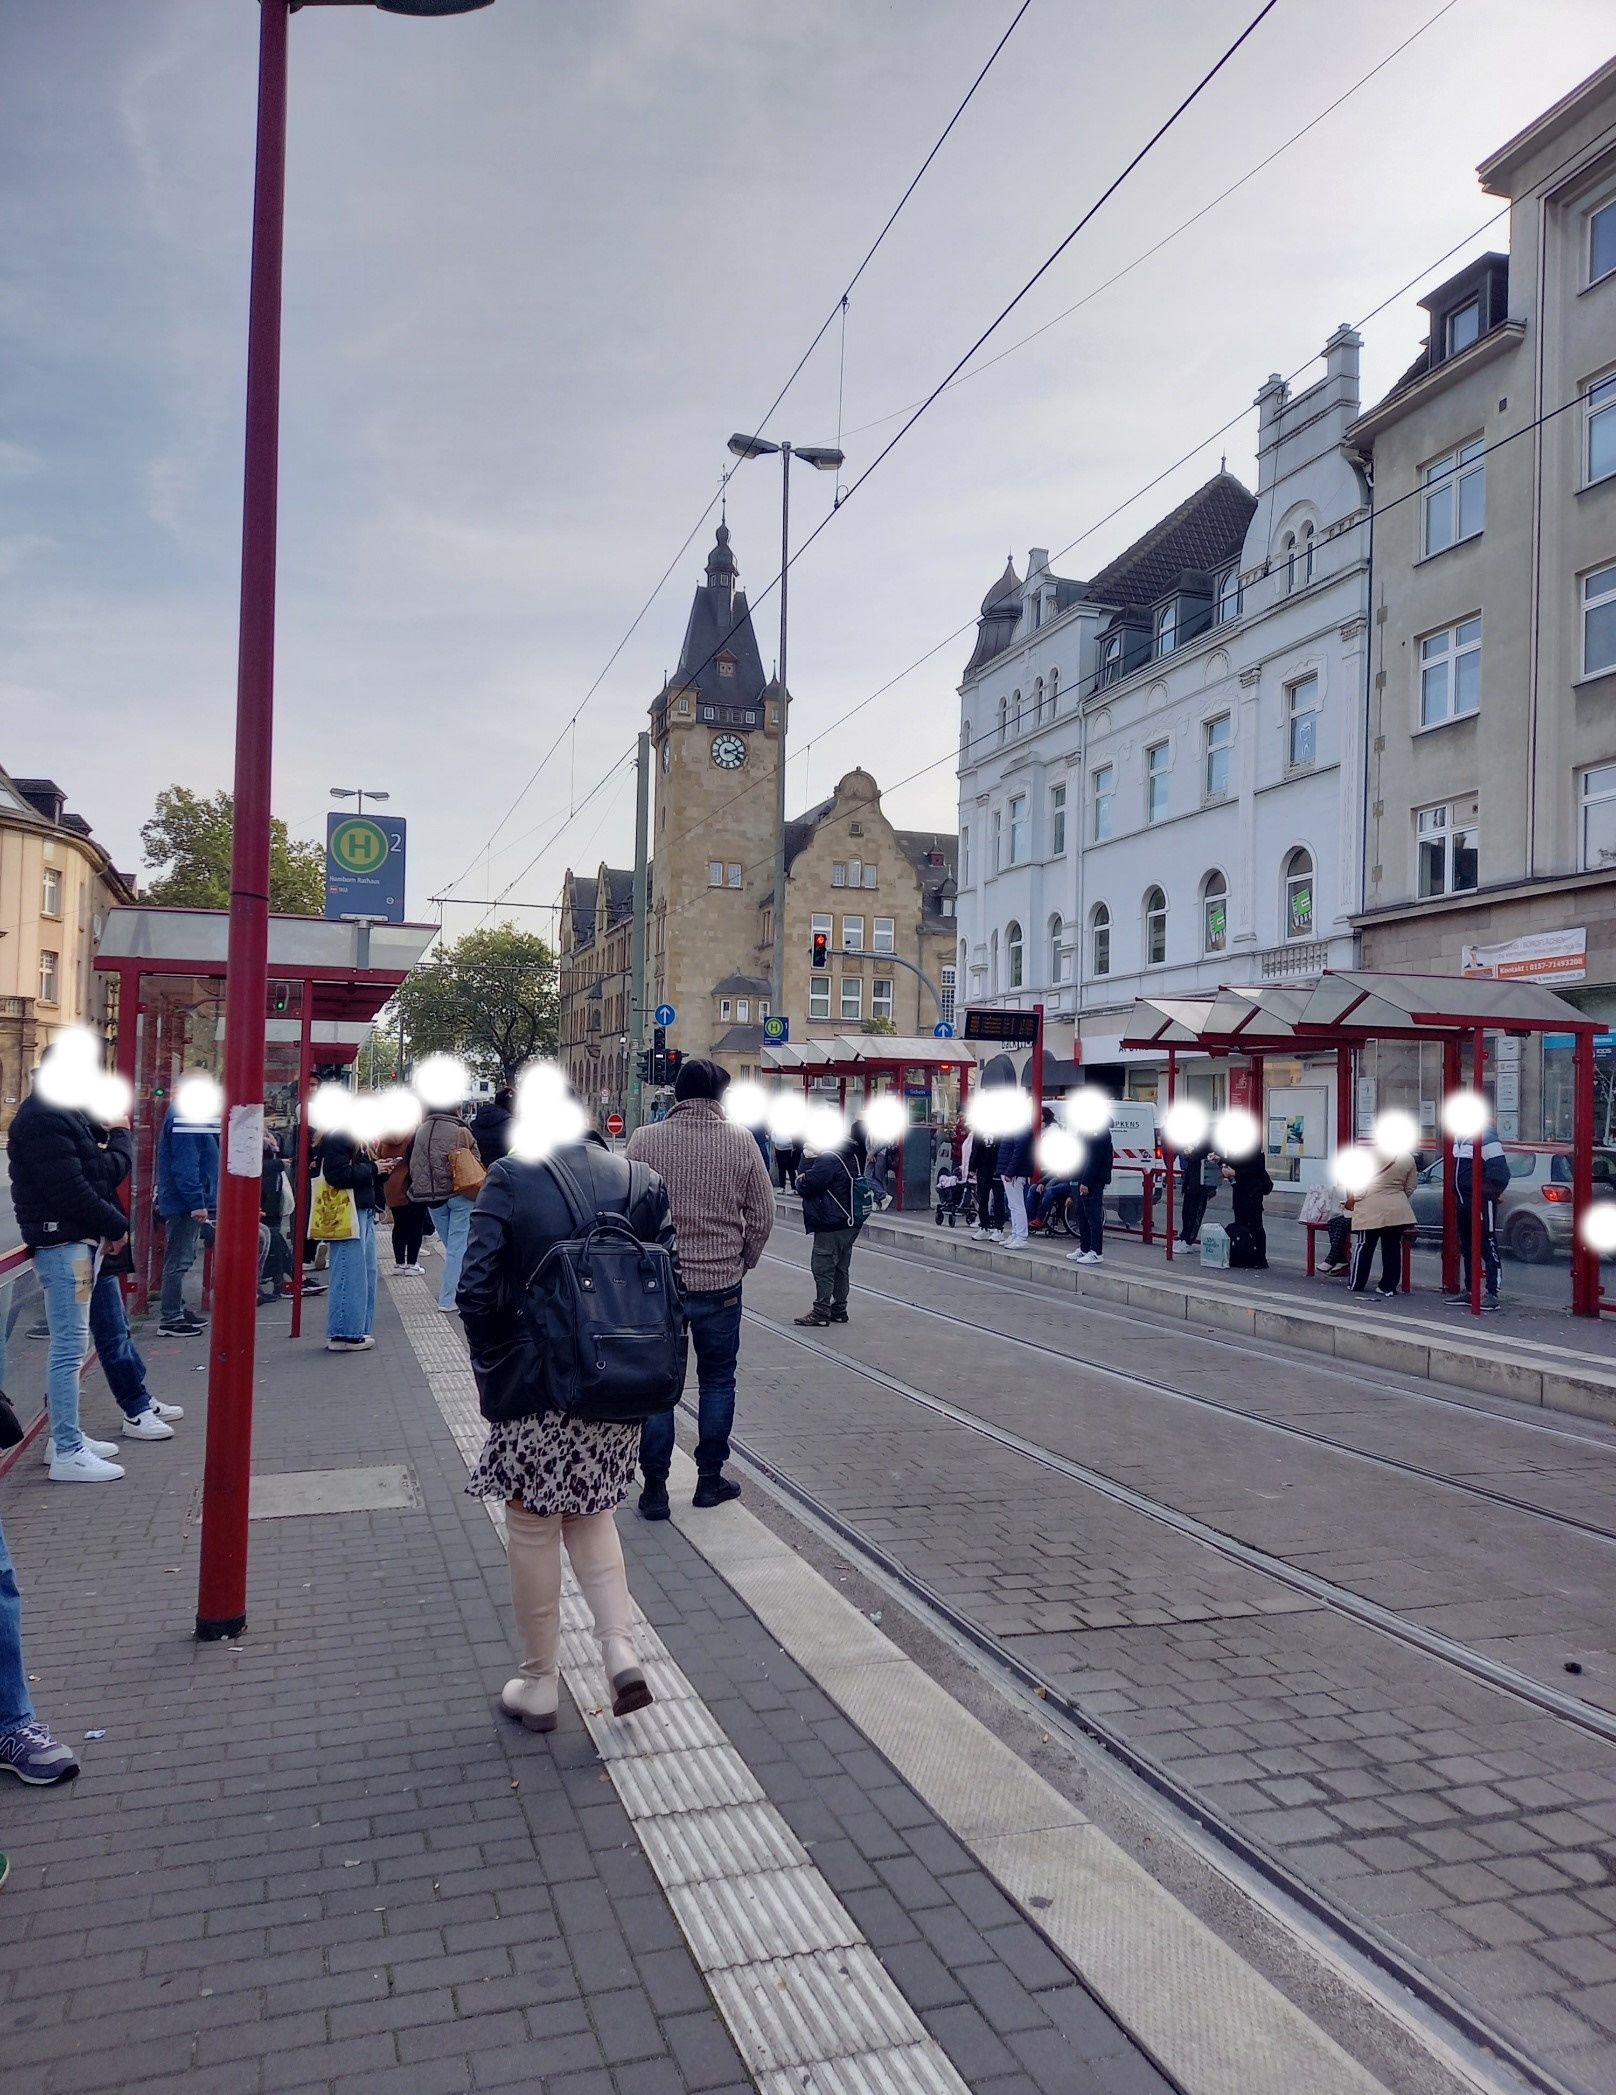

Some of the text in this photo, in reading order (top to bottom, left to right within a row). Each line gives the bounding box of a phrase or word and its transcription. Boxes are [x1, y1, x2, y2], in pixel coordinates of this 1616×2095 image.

[348, 833, 372, 858] H
[390, 833, 402, 852] 2
[1499, 965, 1525, 974] Kontakt
[771, 1023, 778, 1031] H
